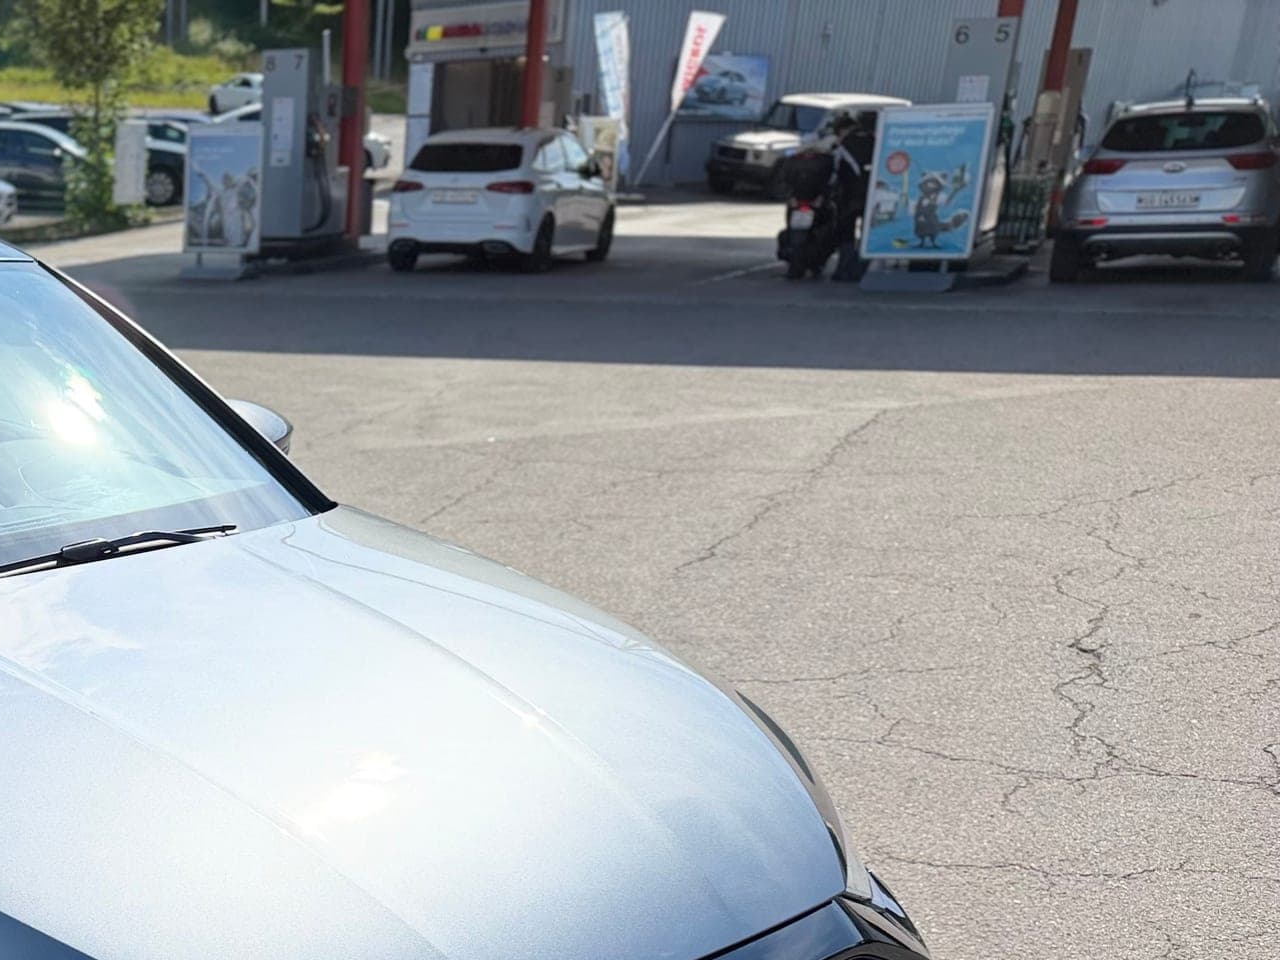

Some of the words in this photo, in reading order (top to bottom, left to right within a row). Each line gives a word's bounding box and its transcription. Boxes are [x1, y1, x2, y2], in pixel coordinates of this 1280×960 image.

[955, 26, 969, 44] 6
[994, 24, 1010, 43] 5
[266, 56, 277, 71] 8
[293, 54, 304, 70] 7
